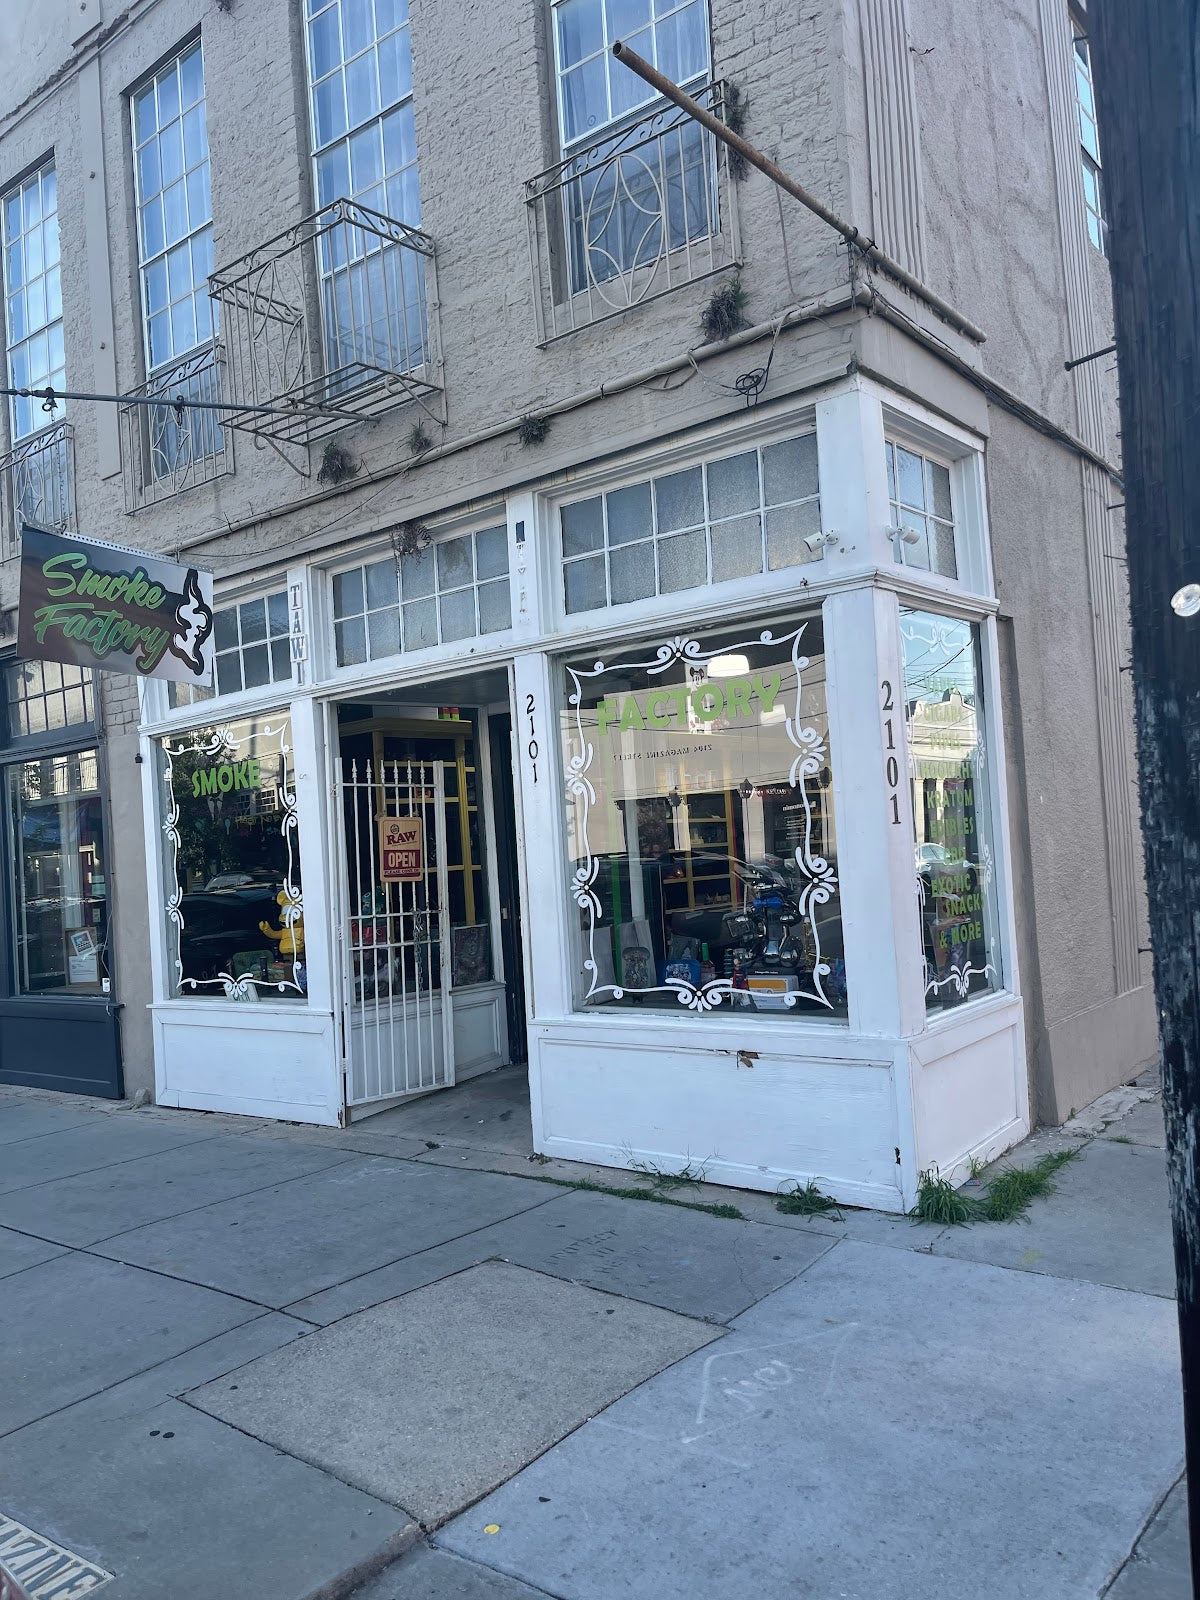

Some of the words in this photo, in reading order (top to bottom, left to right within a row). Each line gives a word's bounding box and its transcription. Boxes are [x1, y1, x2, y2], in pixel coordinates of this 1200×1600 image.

[42, 552, 166, 610] Smoke
[34, 603, 170, 670] Factory
[597, 674, 782, 737] FACTORY
[526, 694, 538, 783] 2101
[881, 680, 901, 825] 2101
[192, 758, 262, 798] SMOKE
[927, 789, 973, 809] KRATOM
[386, 831, 417, 845] RAW
[930, 816, 974, 838] EDIBLES
[388, 852, 416, 868] OPEN
[931, 873, 971, 897] EXOTIC
[945, 893, 985, 917] SNACKS
[939, 931, 947, 949] &
[951, 921, 982, 945] MORE
